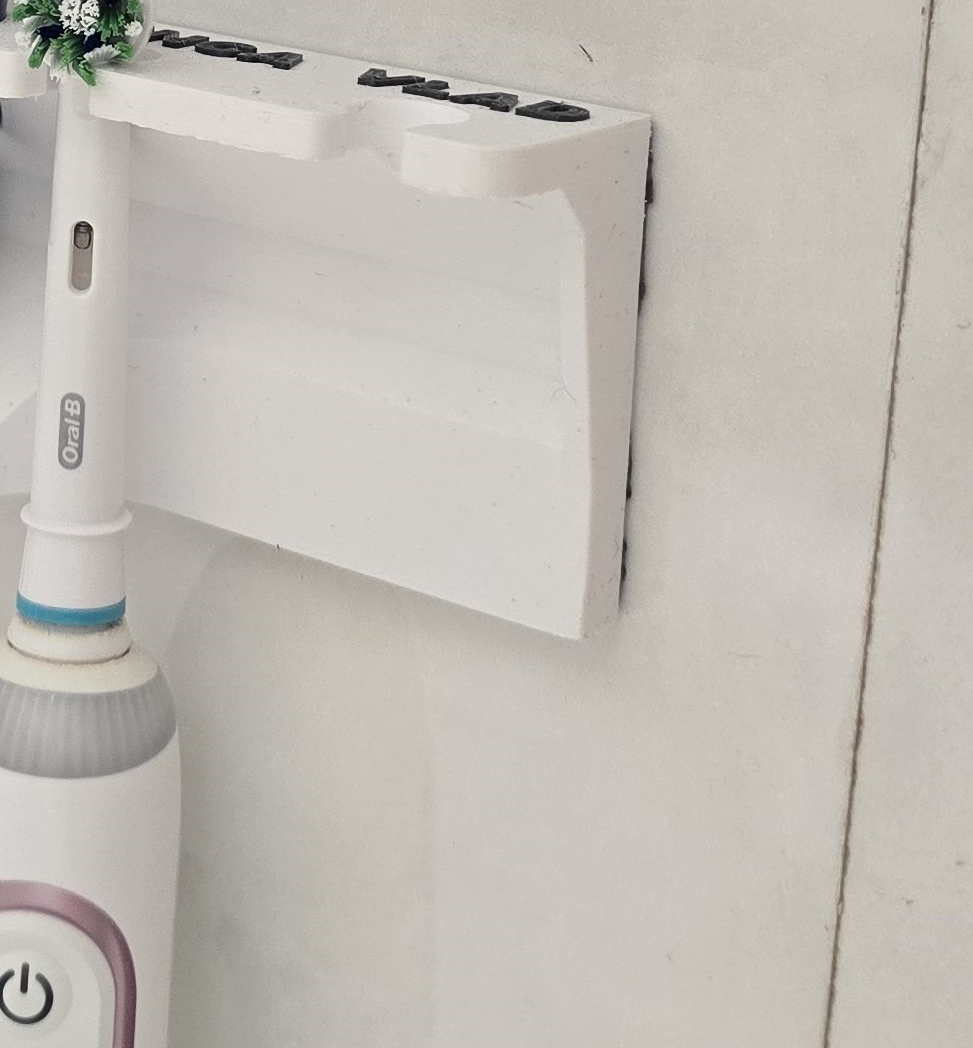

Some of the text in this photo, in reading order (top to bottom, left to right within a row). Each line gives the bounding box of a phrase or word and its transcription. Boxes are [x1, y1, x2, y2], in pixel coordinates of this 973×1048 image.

[148, 26, 303, 70] NCA
[357, 67, 590, 123] VLAD
[62, 398, 81, 464] Oral-B
